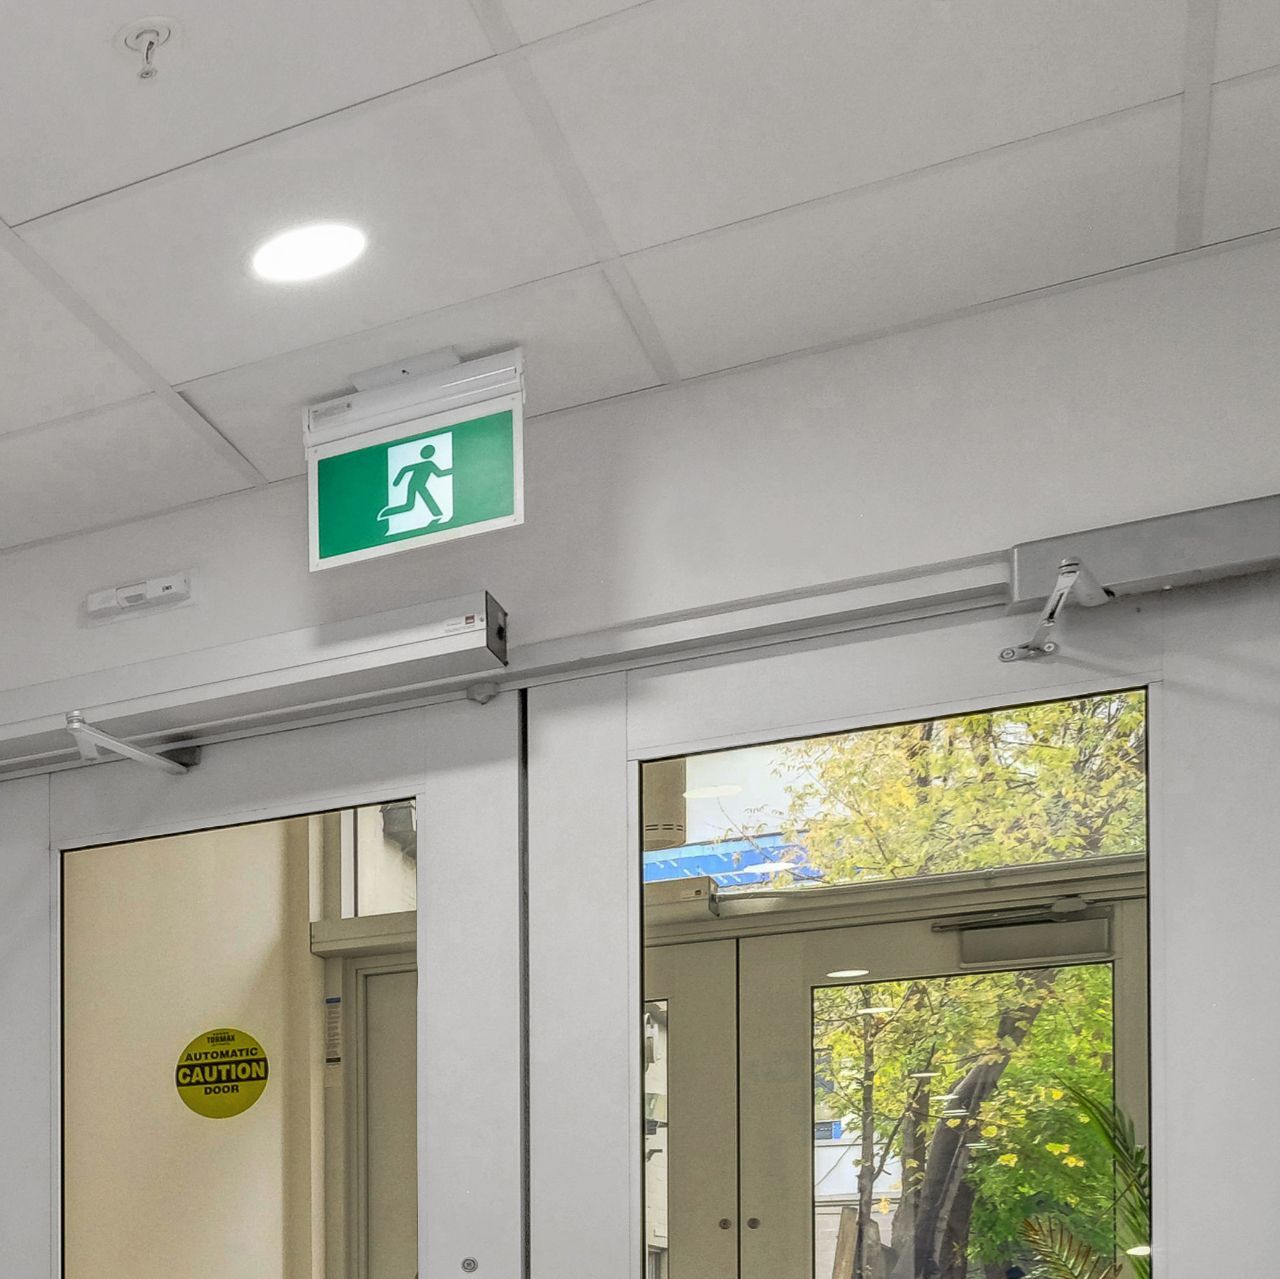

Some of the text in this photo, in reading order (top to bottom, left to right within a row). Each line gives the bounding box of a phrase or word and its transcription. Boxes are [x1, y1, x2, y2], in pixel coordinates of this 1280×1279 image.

[185, 1047, 258, 1062] AUTOMATIC
[177, 1061, 266, 1084] CAUTION
[204, 1084, 240, 1095] DOOR
